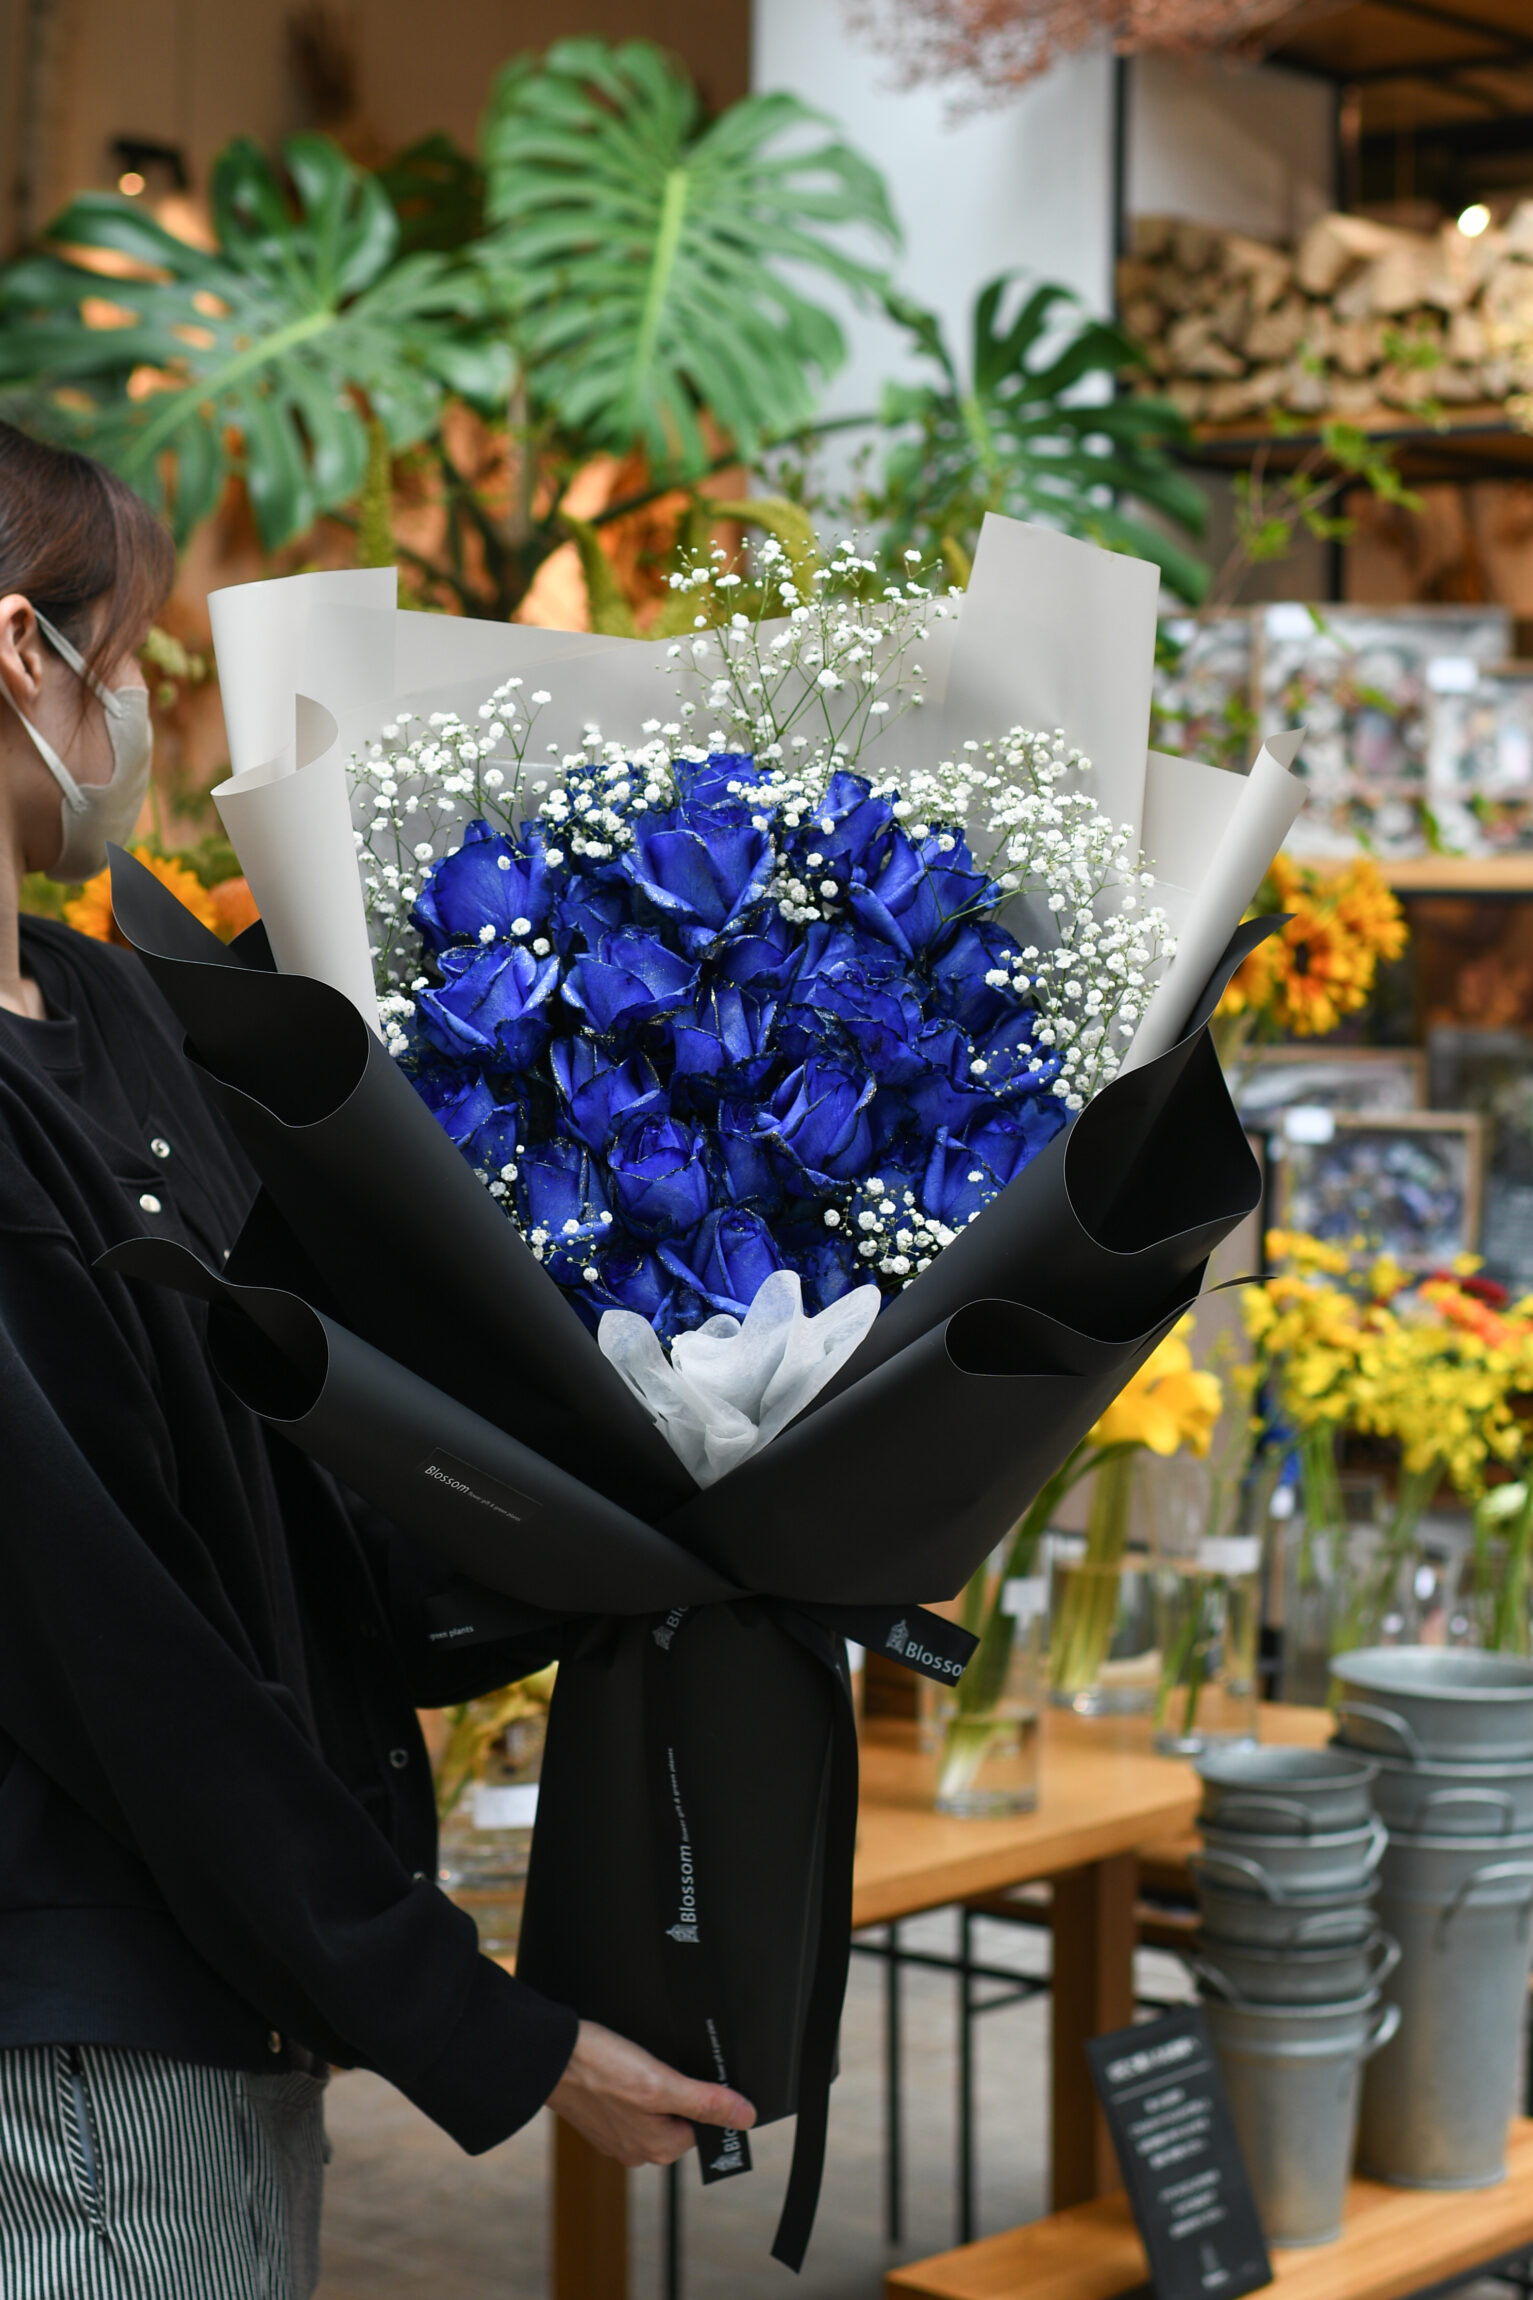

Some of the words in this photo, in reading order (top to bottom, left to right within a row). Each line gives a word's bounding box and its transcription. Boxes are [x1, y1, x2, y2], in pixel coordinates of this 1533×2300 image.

[424, 1465, 471, 1494] Blossom
[449, 1626, 474, 1638] plants
[905, 1641, 967, 1677] Blosso
[679, 1845, 697, 1922] Blossom
